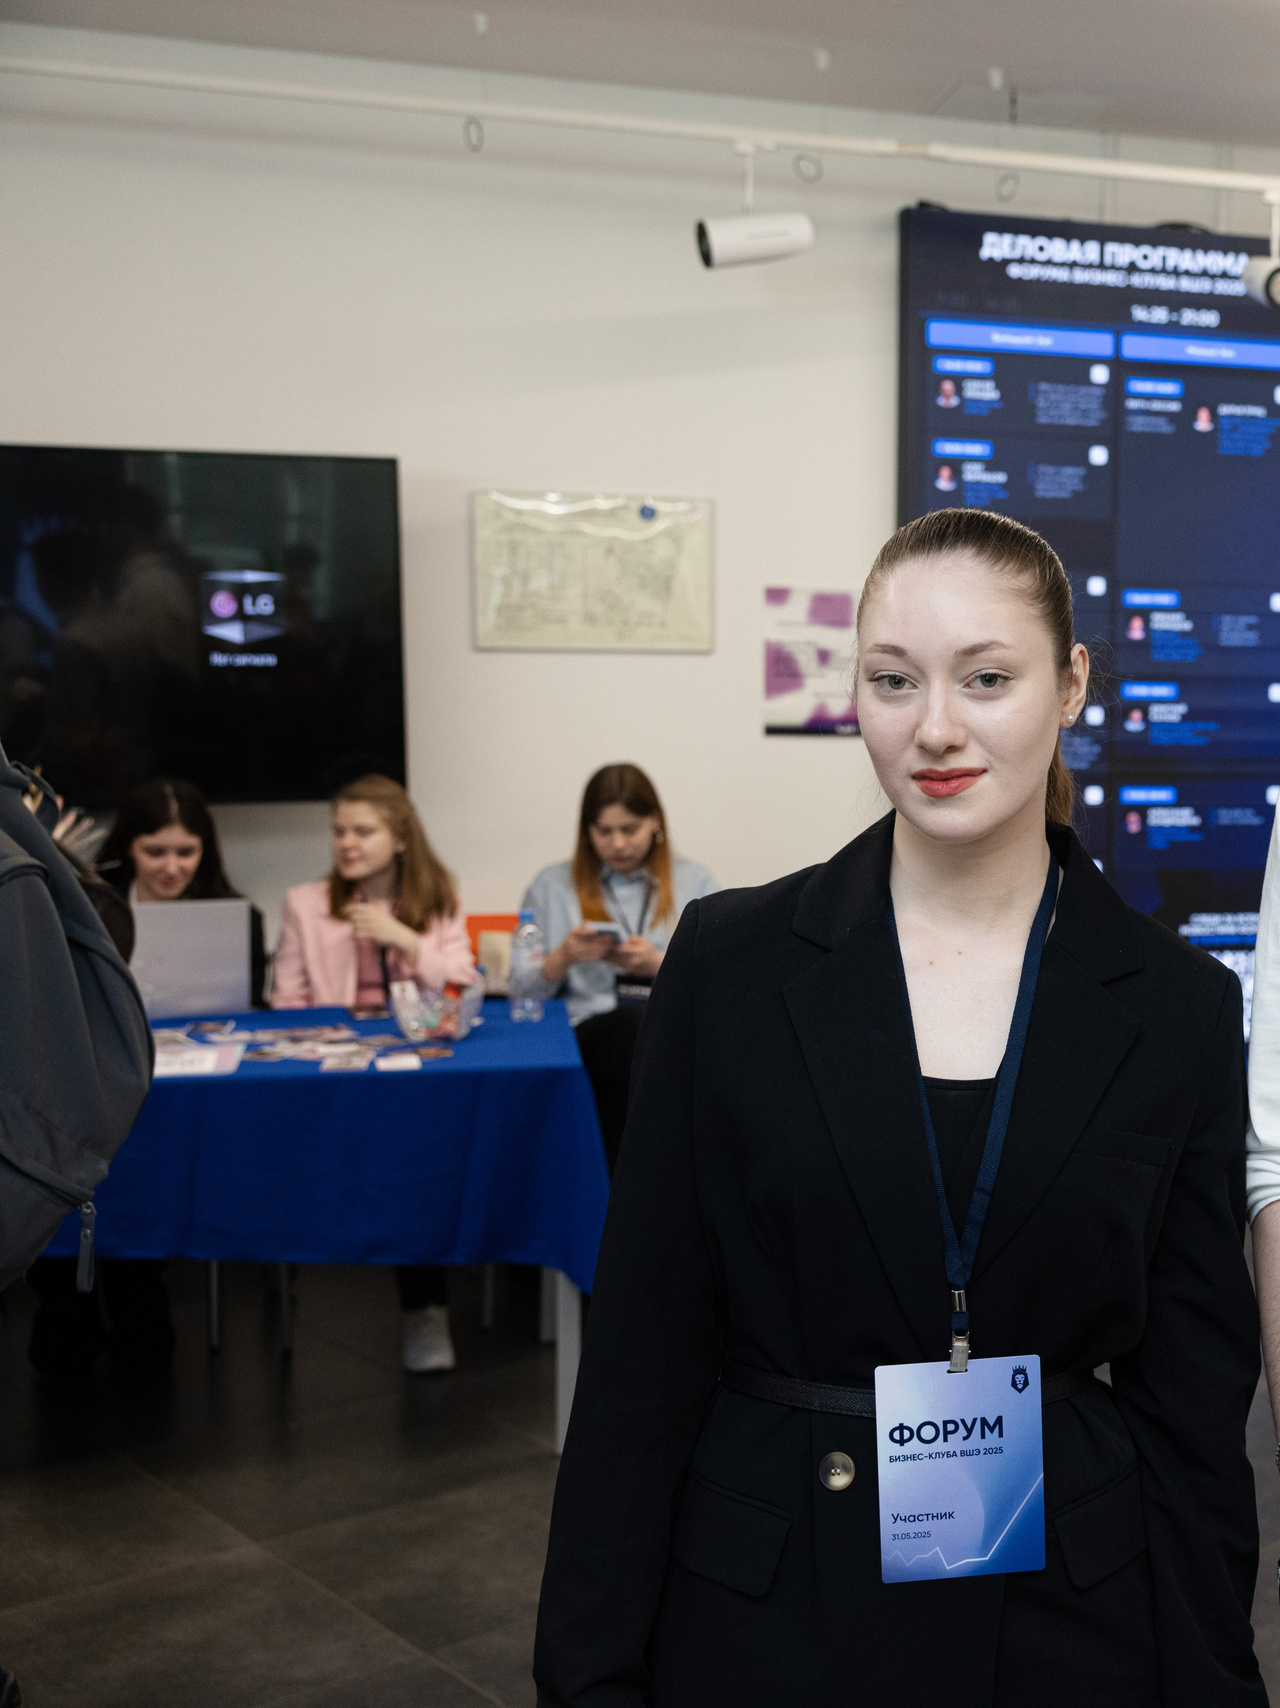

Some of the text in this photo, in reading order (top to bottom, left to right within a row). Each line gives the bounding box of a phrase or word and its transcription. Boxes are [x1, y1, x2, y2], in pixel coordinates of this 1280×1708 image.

[979, 231, 1100, 266] ДЕЛОВАЯ
[1006, 262, 1071, 282] ФОРУМА
[1072, 266, 1177, 291] БИЗНЕС-КЛУБА
[242, 594, 275, 616] LG
[888, 1415, 1004, 1446] ФОРУМ
[889, 1447, 1004, 1463] БИЗНЕС-КЛУБА ВШЭ 2025
[891, 1511, 955, 1525] Участник
[892, 1531, 931, 1541] 31.05.2025
